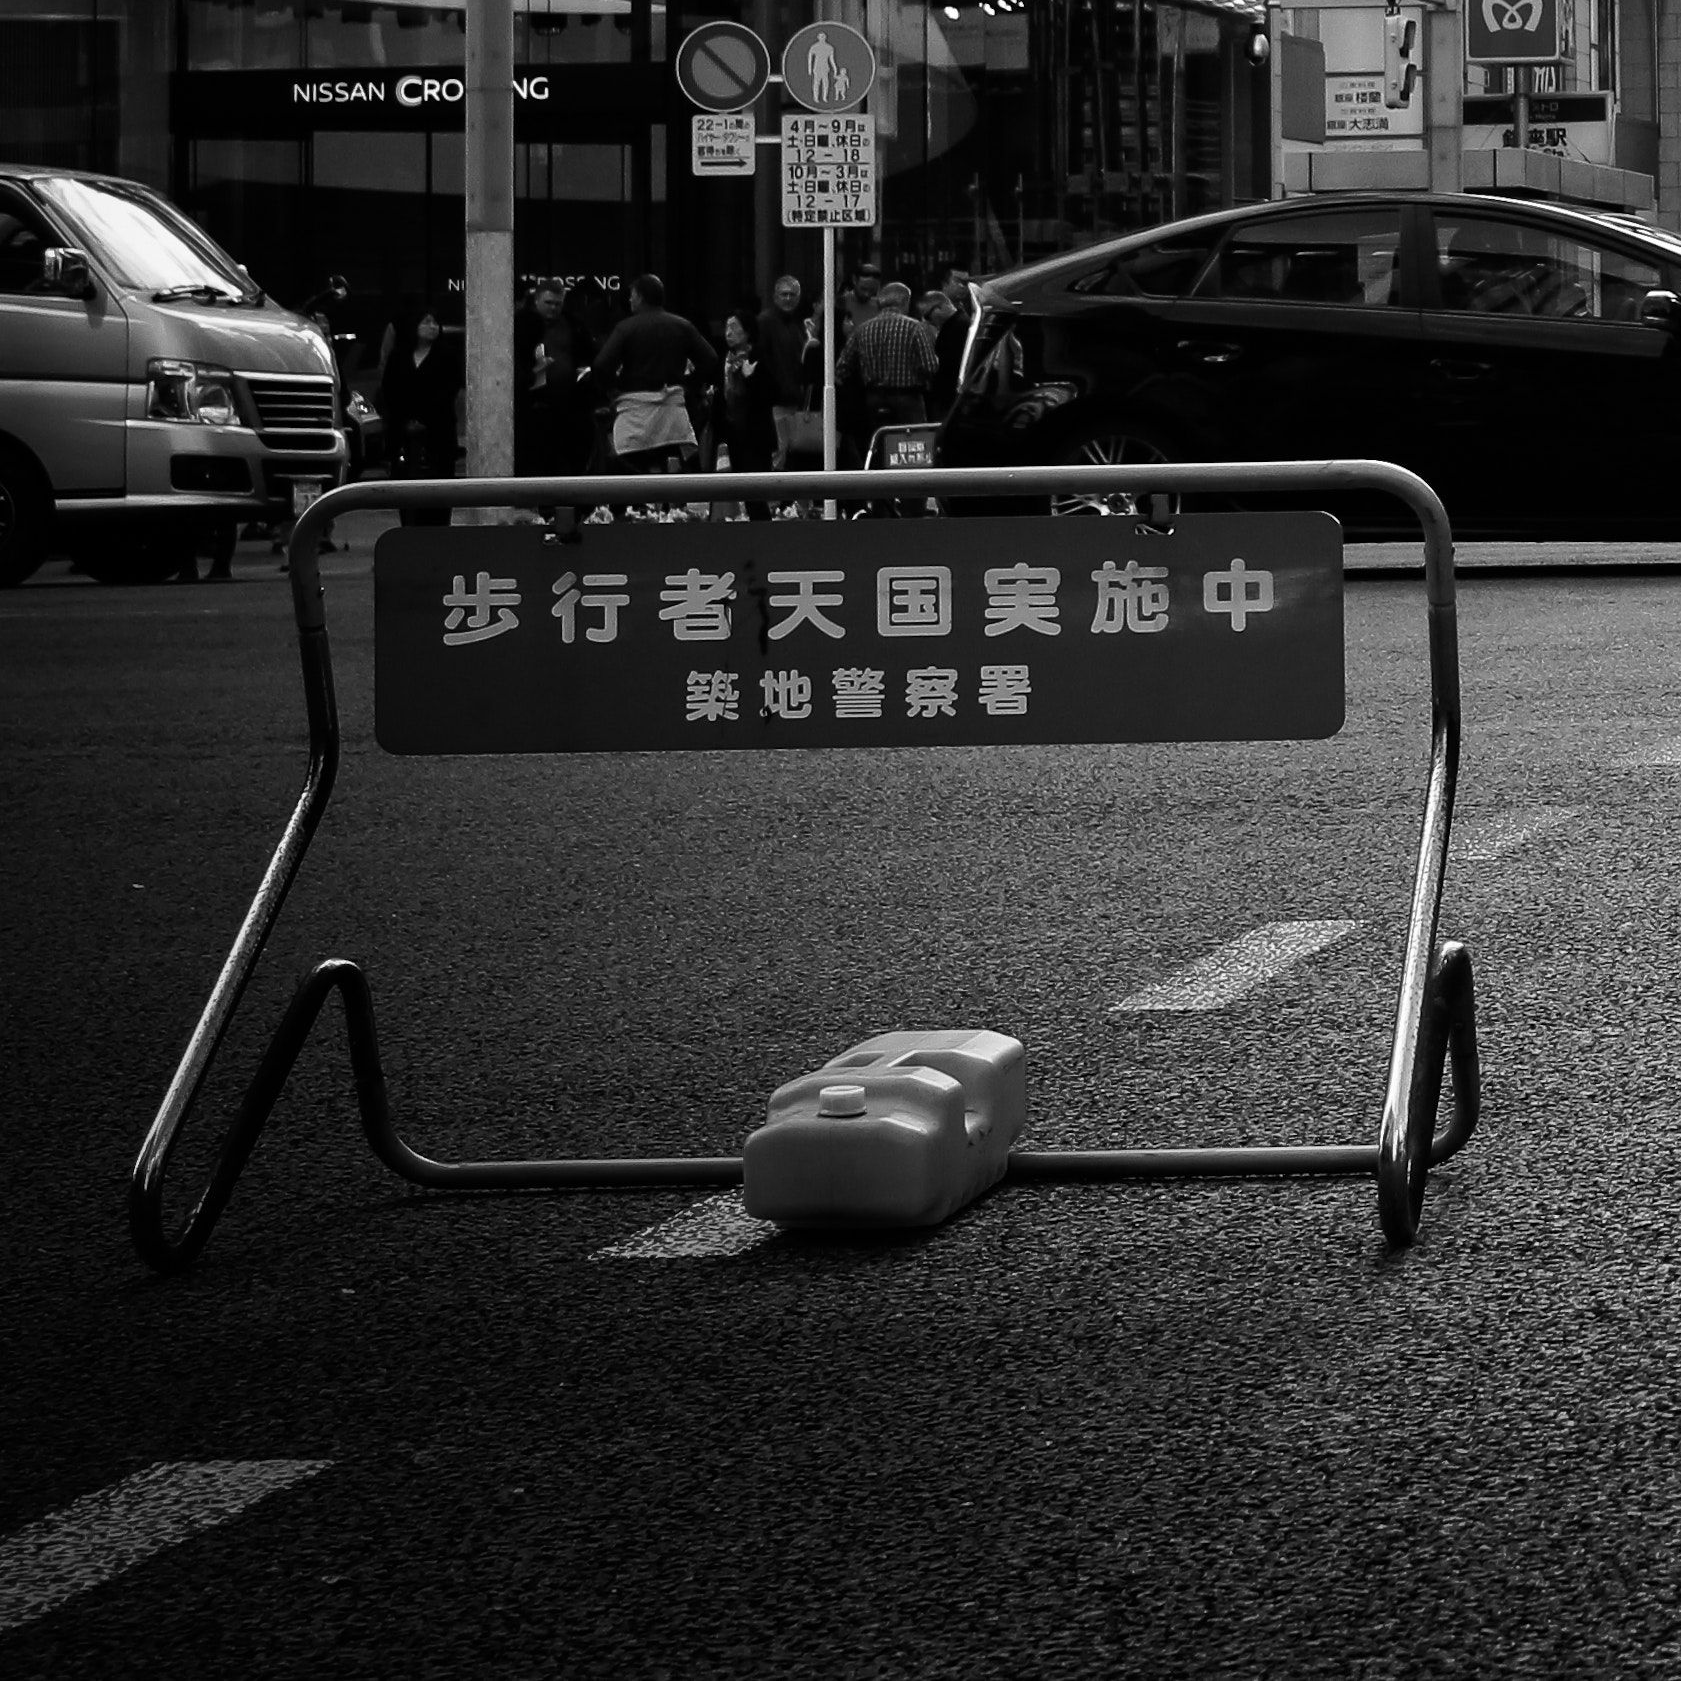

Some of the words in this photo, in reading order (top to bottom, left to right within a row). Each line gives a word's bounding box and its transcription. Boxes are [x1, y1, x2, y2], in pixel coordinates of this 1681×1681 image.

[292, 81, 386, 104] NISSAN
[396, 75, 550, 106] CRONG
[441, 558, 1277, 648] 歩行者天国実施中
[685, 663, 1034, 723] 築地警察署
